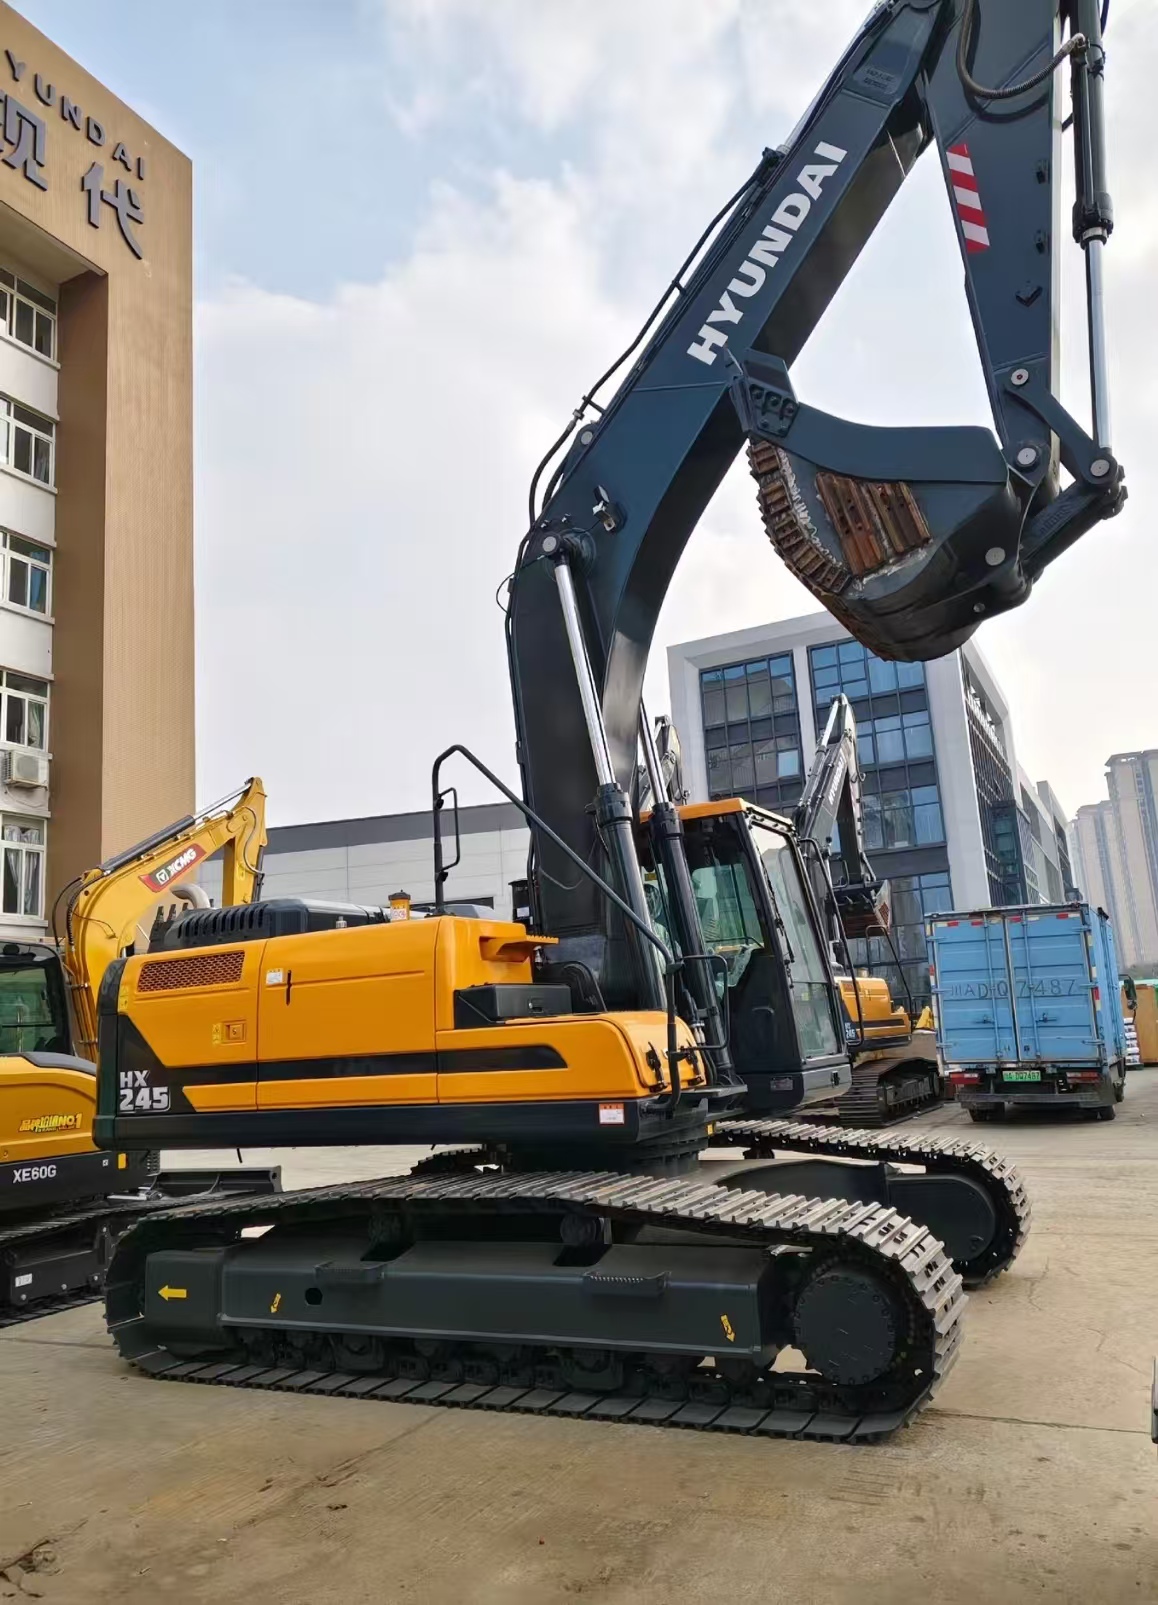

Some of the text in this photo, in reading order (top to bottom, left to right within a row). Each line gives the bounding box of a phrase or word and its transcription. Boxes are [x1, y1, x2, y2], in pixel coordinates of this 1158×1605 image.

[5, 49, 144, 181] YUNDAI
[686, 140, 848, 366] HYUNDAI
[168, 848, 197, 876] XCMG
[119, 1070, 150, 1088] HX
[119, 1086, 170, 1112] 245
[13, 1164, 57, 1184] XE60G
